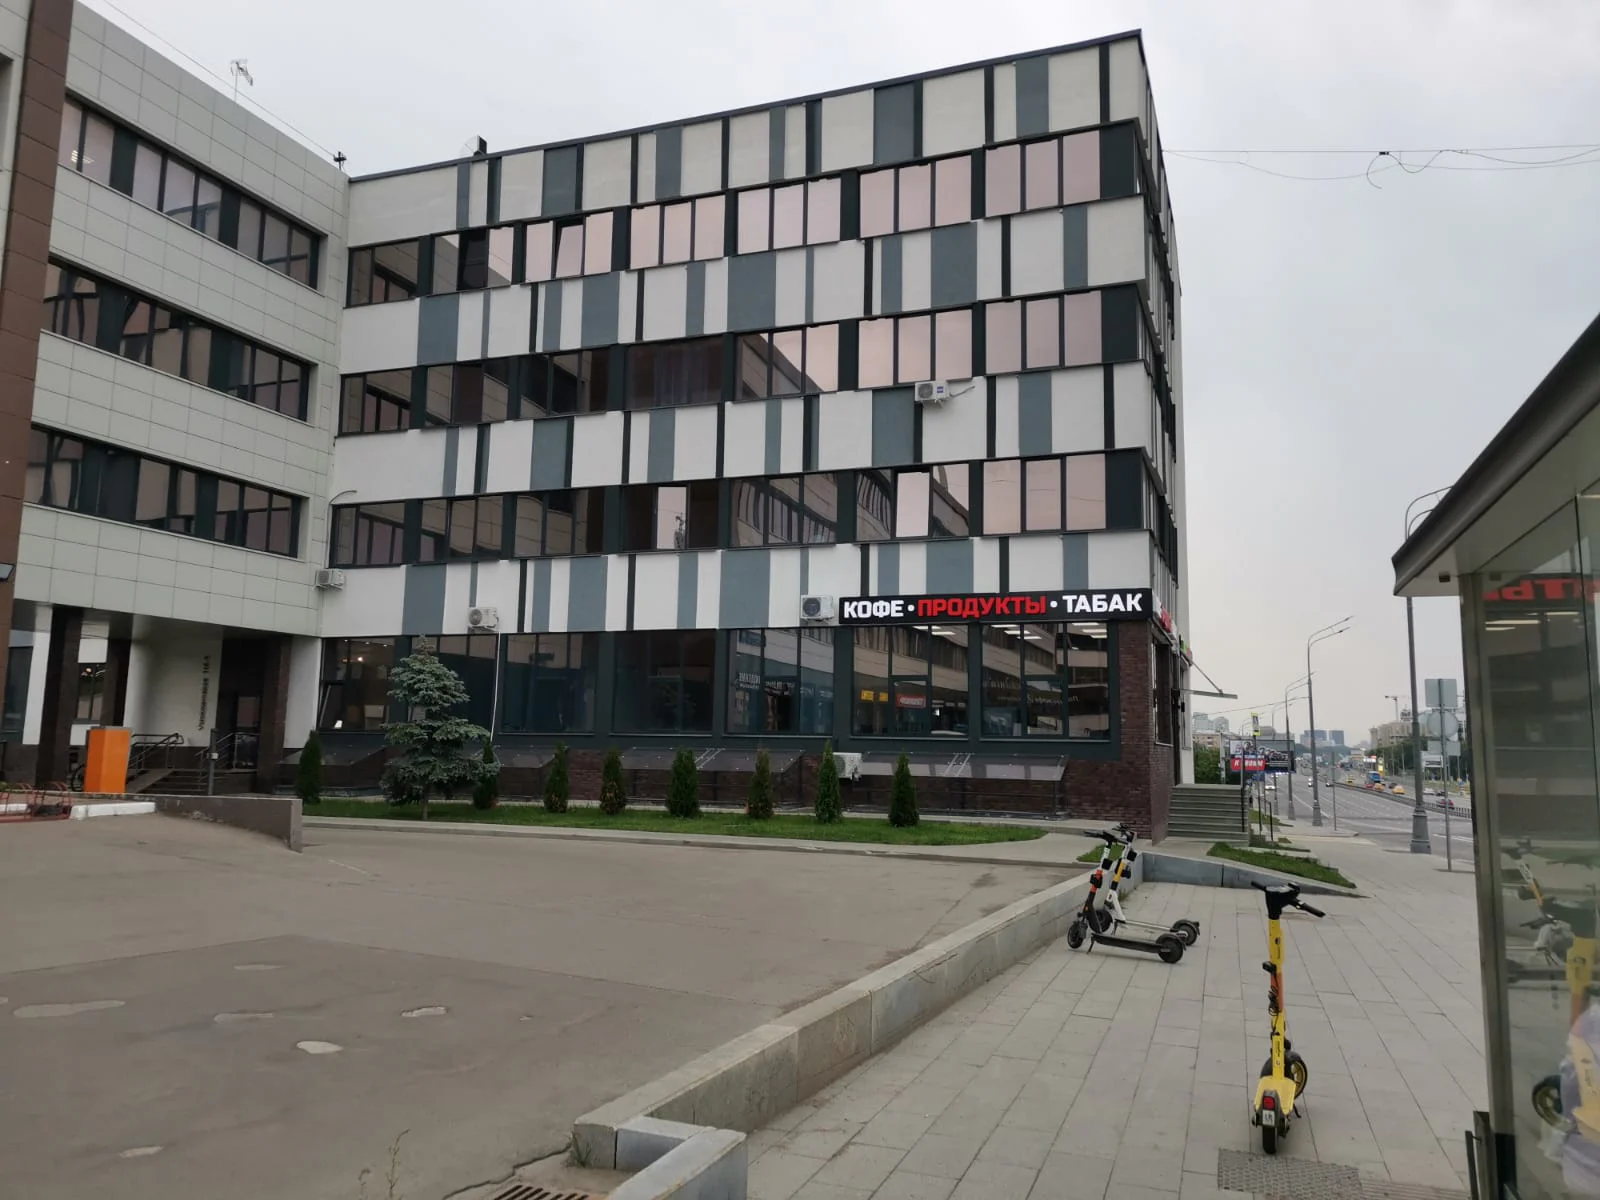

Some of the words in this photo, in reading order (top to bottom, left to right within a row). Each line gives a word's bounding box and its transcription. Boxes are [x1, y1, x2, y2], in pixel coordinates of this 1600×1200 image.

[843, 599, 904, 619] КОФЕ
[917, 595, 1046, 620] ПРОДУКТЫ
[1062, 592, 1142, 614] ТАБАК
